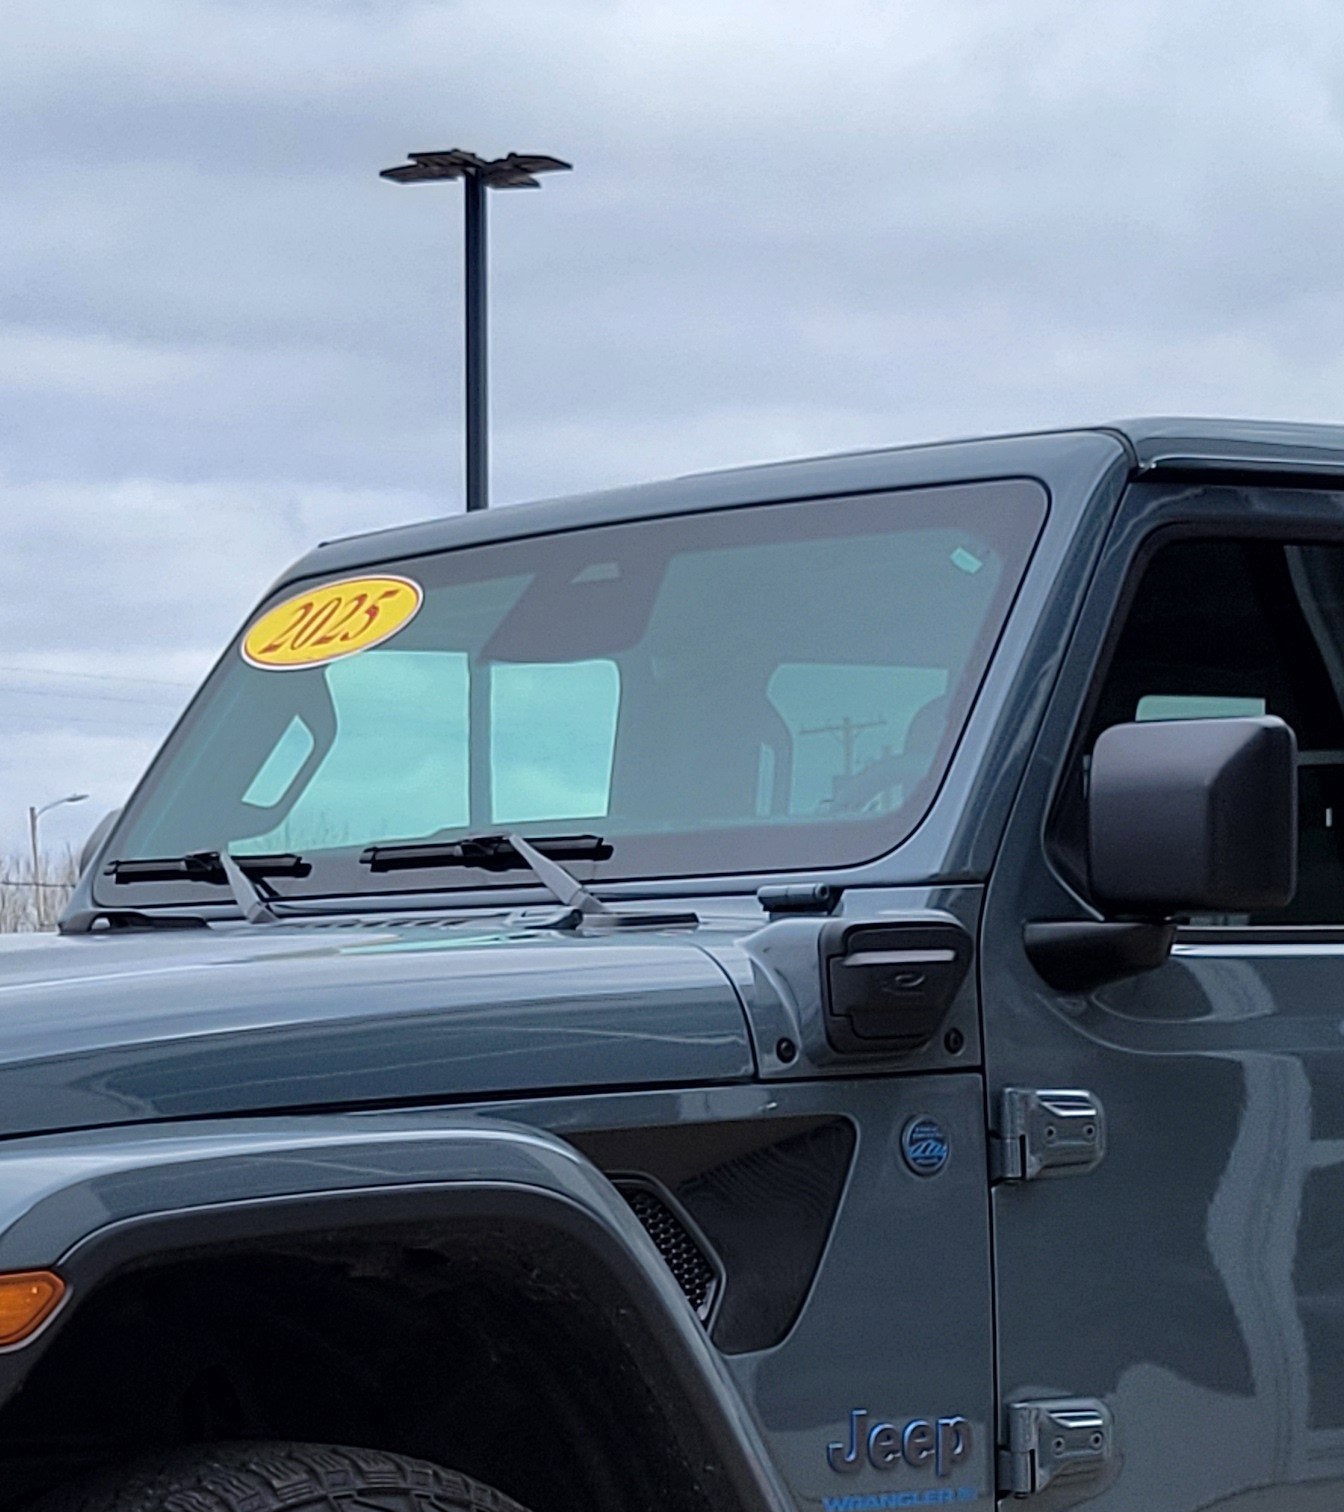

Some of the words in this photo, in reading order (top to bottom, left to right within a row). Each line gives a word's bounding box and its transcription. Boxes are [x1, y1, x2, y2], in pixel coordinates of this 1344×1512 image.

[258, 589, 400, 654] 2025
[827, 1408, 972, 1477] Jeep
[822, 1489, 954, 1512] WRANGLER
